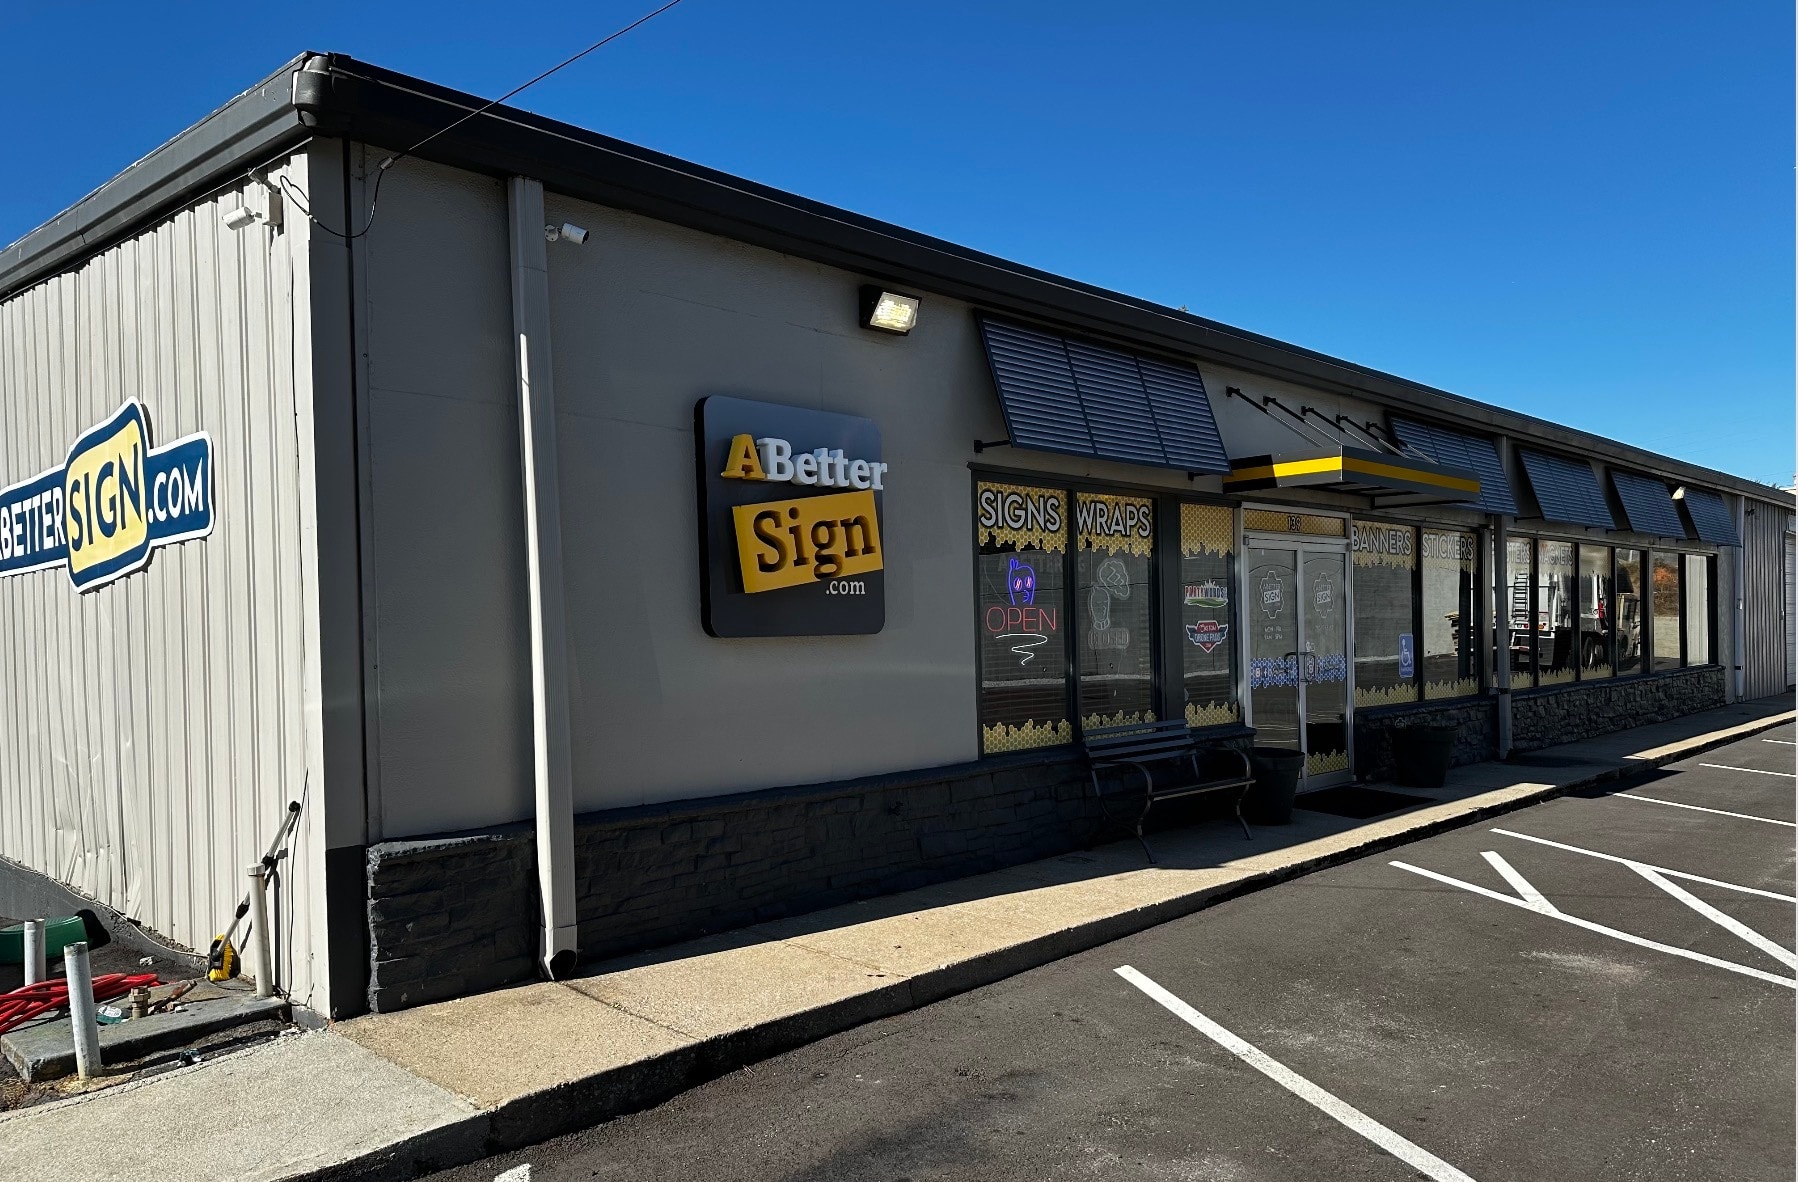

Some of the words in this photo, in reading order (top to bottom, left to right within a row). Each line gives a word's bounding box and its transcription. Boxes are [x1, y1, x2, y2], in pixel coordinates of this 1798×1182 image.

[0, 486, 67, 561] BETTER
[979, 490, 1061, 532] SIGNS
[1077, 502, 1151, 537] WRAPS
[753, 506, 877, 581] Sign
[1352, 526, 1412, 555] BANNERS
[1422, 533, 1474, 560] STICKERS
[825, 580, 866, 595] .com
[986, 606, 1057, 632] OPEN
